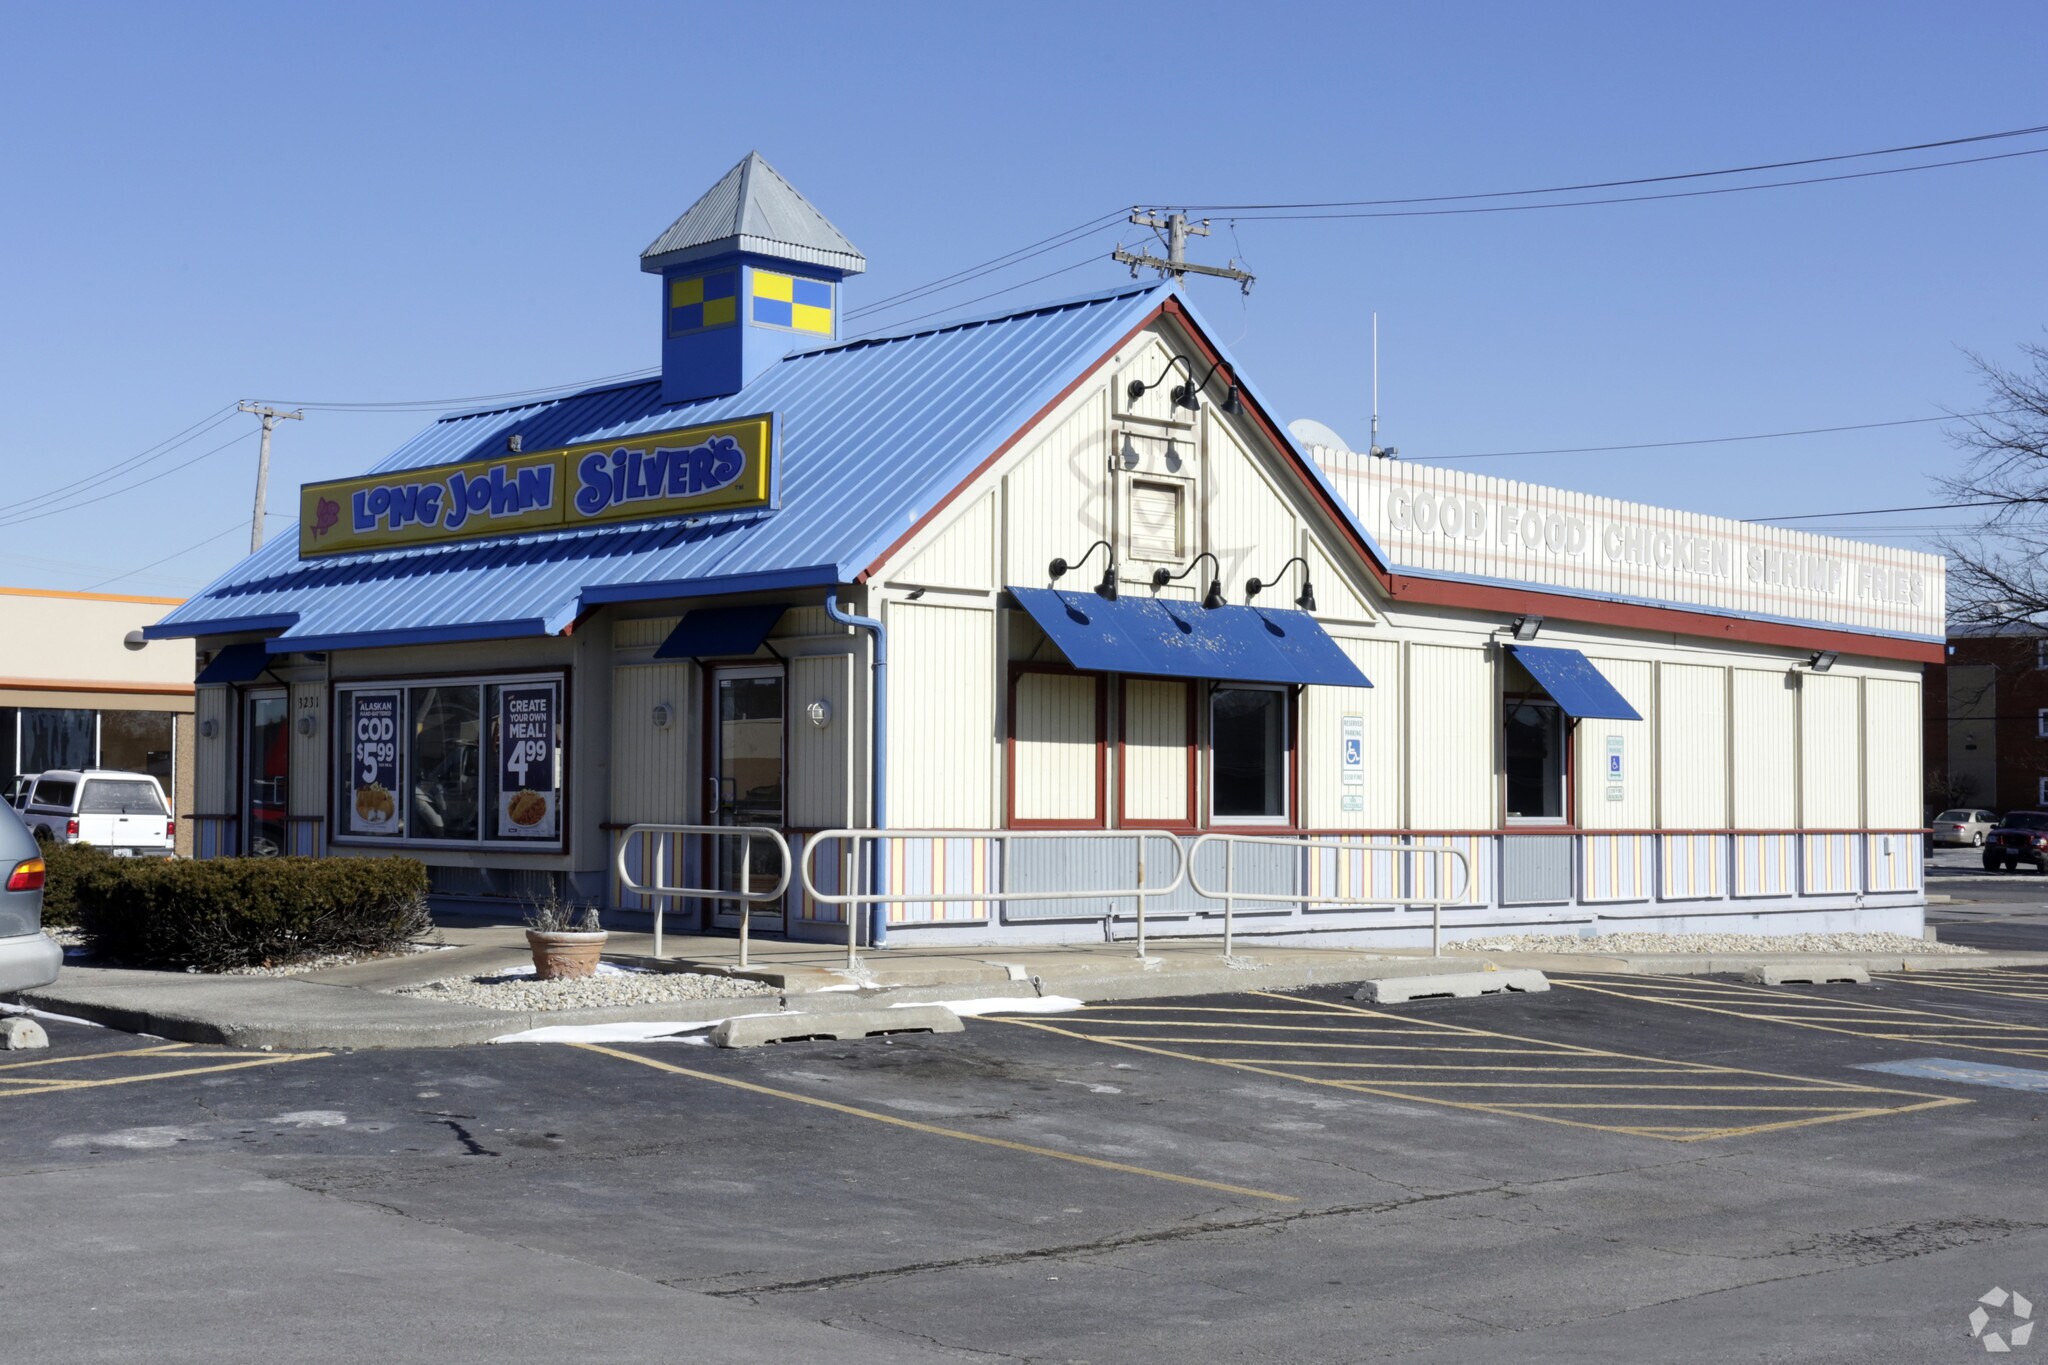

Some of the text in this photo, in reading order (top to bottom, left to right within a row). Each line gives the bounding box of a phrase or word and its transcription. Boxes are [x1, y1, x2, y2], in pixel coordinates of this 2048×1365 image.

[353, 485, 444, 530] LONG
[1387, 487, 1925, 607] GOOD FOOD CHICKEN SHRIMP FRIES
[299, 696, 319, 710] 3231
[360, 701, 392, 711] ALASKAN
[509, 698, 547, 713] CREATE
[509, 712, 547, 723] YOUR OWN
[357, 717, 394, 741] COD
[509, 723, 547, 739] MEAL!
